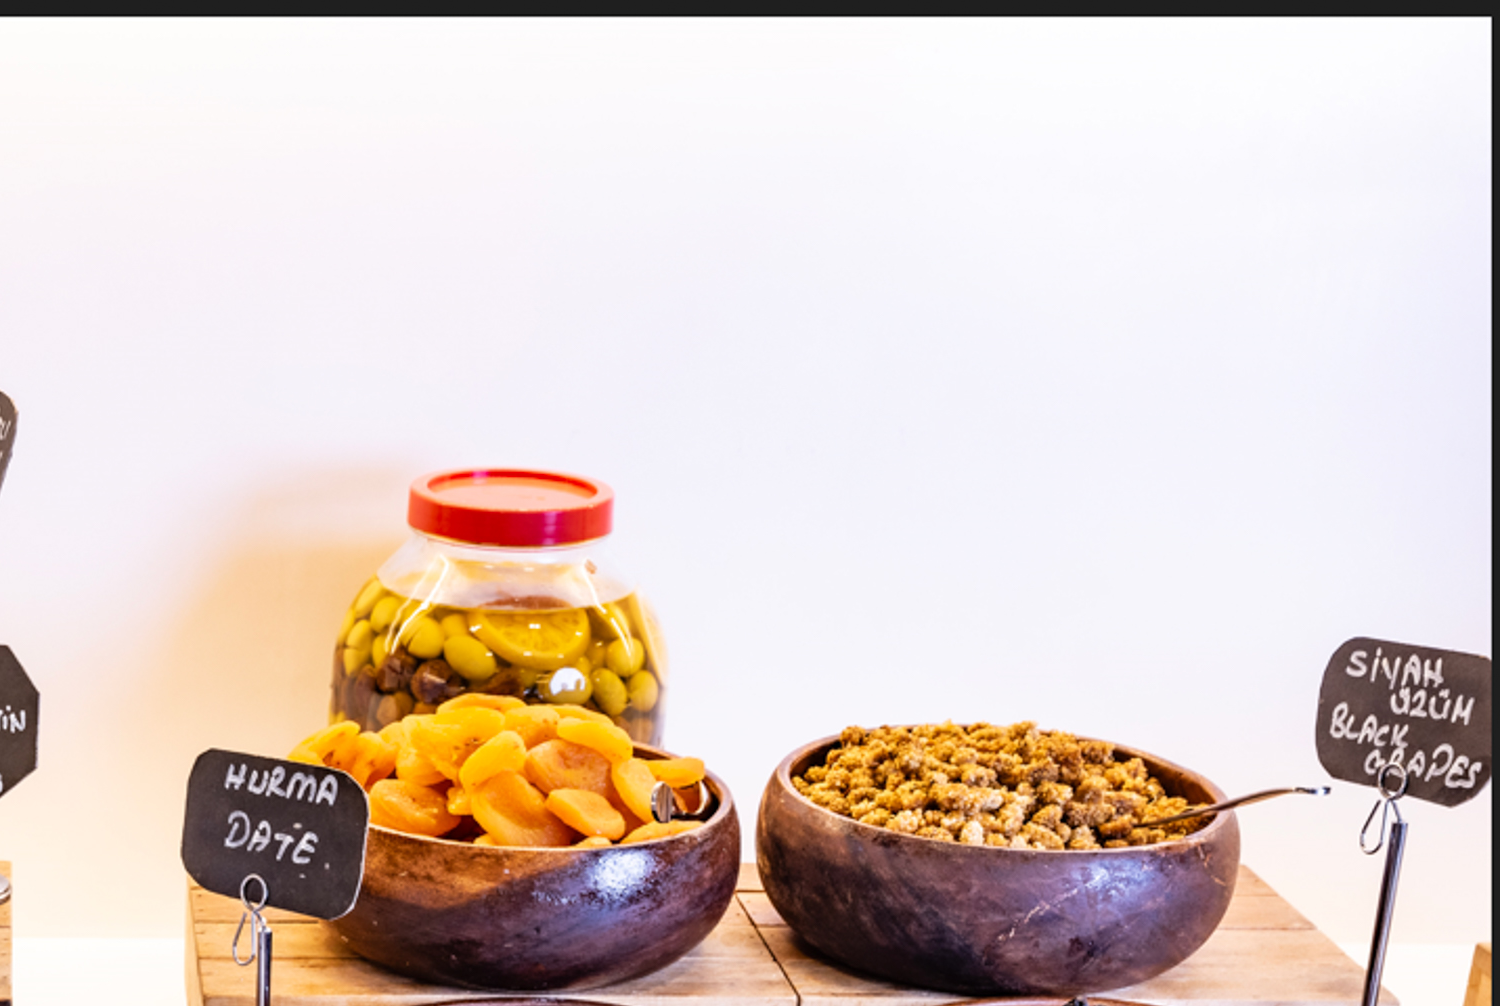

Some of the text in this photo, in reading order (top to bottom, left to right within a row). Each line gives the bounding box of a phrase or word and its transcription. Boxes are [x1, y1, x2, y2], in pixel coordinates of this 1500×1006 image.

[1330, 701, 1409, 748] BLACK
[1390, 686, 1475, 725] ÜZÜM
[224, 763, 339, 805] HURMA
[1364, 743, 1482, 788] GRAPES
[224, 810, 319, 864] DATE
